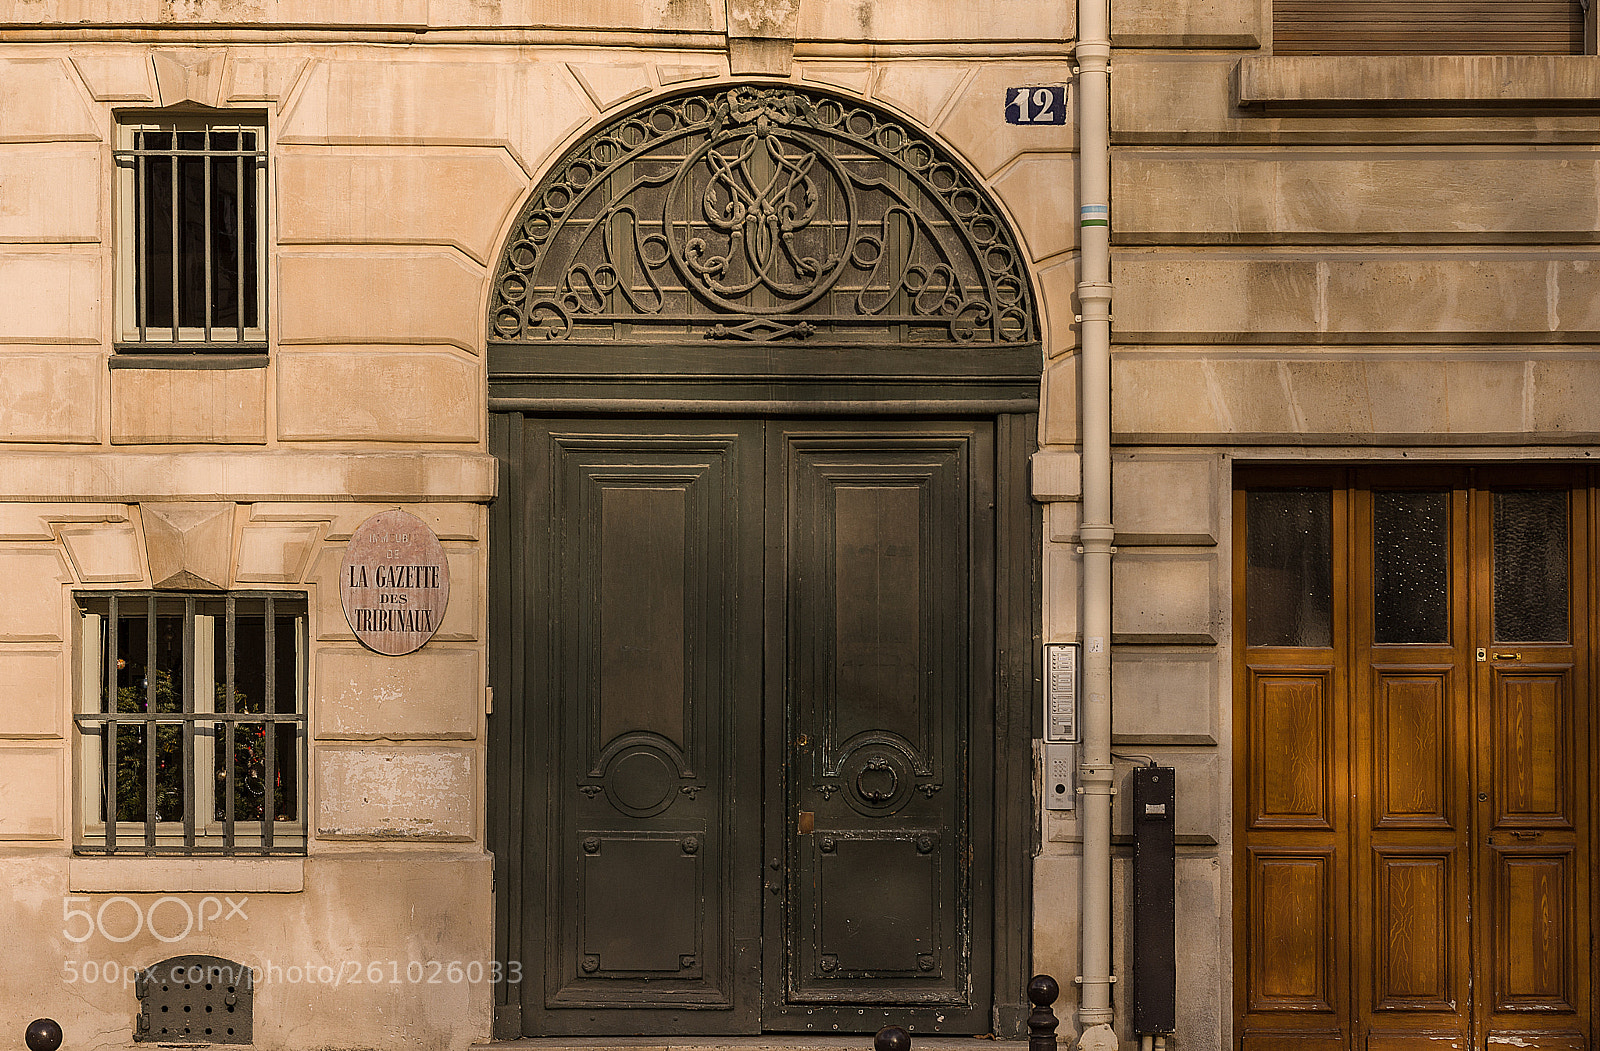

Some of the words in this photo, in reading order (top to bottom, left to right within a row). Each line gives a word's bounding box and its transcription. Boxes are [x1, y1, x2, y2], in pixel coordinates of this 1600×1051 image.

[1006, 88, 1054, 122] 12
[349, 565, 368, 588] LA
[375, 565, 440, 589] GAZETTE
[379, 594, 408, 604] DES
[354, 608, 433, 632] TRIBUNAUX
